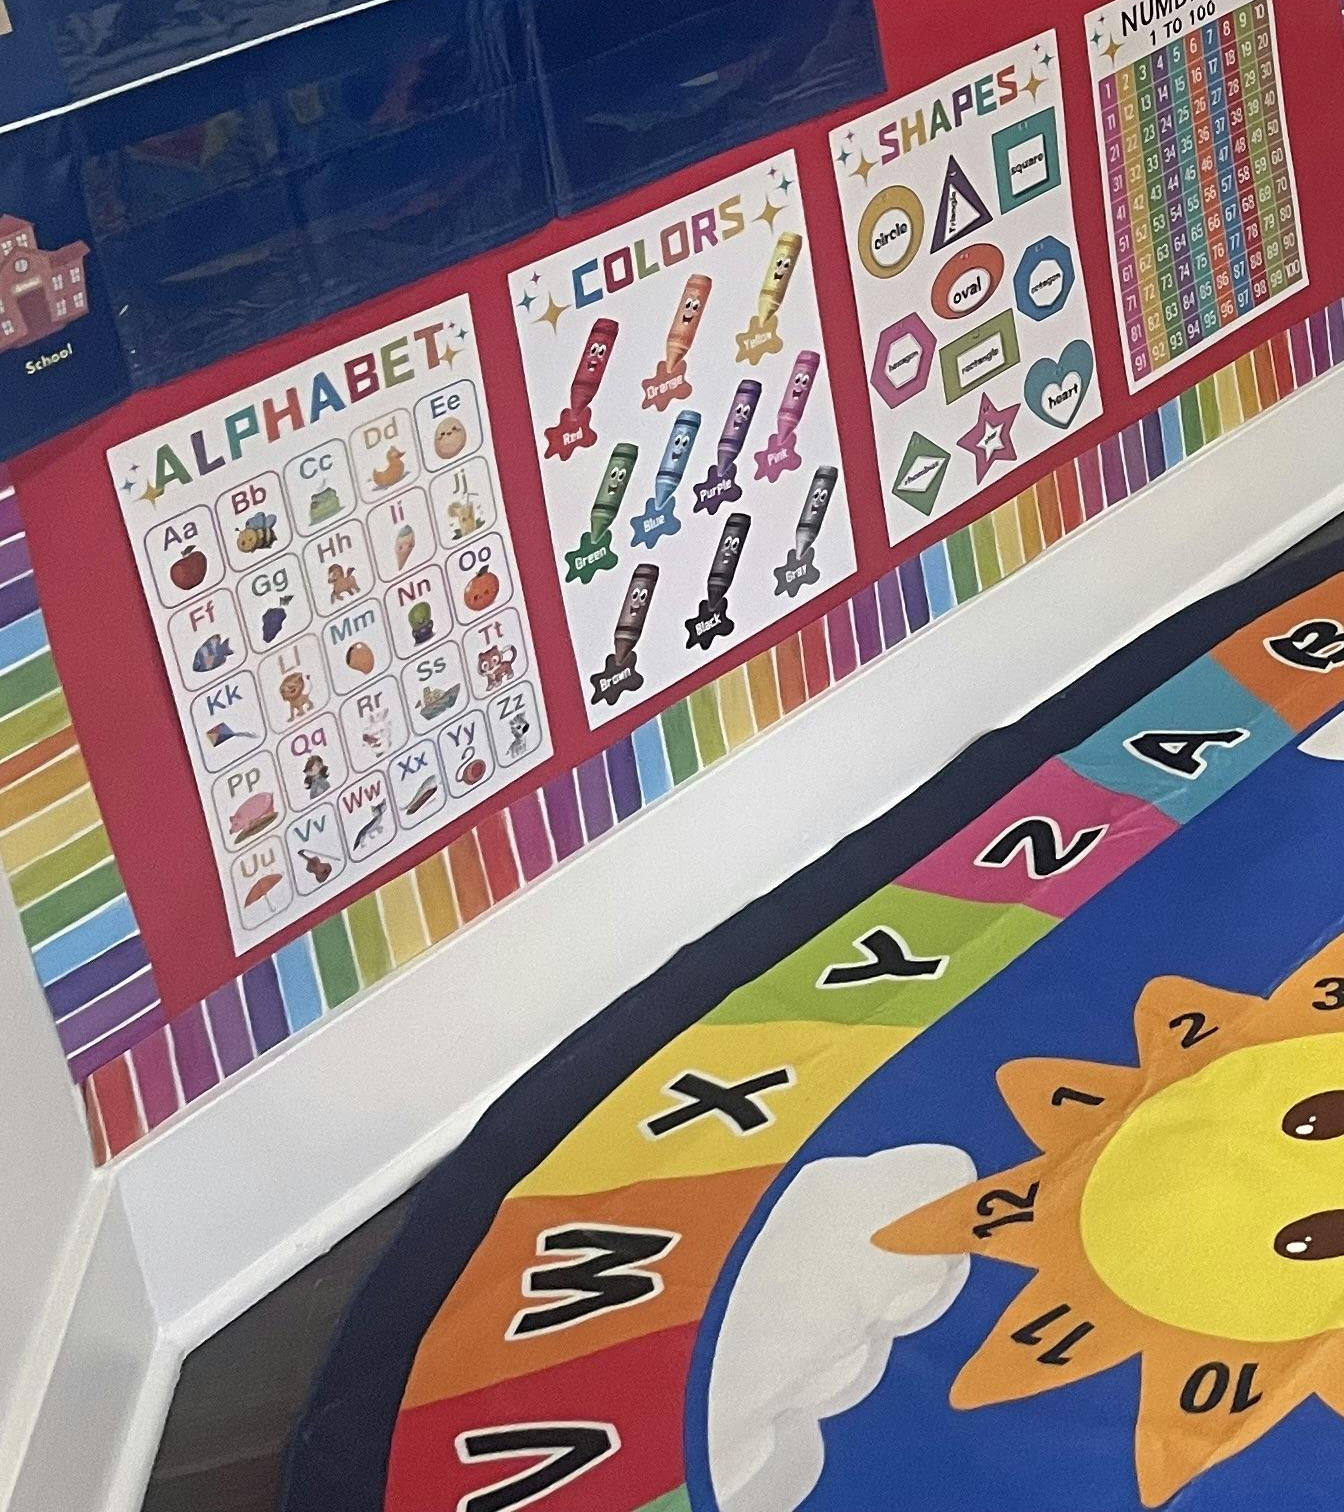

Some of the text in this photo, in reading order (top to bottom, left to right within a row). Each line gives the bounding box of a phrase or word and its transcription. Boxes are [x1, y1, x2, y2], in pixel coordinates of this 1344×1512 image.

[1149, 0, 1216, 47] 1 TO 100
[1105, 3, 1265, 99] 1 2 3 4 5 6 7 8 9 10
[878, 64, 1018, 166] SHAPES
[571, 194, 745, 309] COLORS
[874, 222, 908, 251] circle
[952, 276, 982, 305] oval
[25, 342, 73, 375] School
[646, 374, 684, 400] Orange
[1047, 383, 1079, 410] heart
[155, 322, 444, 496] ALPHABET
[431, 391, 461, 419] Ee
[362, 415, 398, 449] Dd
[562, 428, 584, 447] Red
[299, 452, 334, 480] Cc
[767, 448, 789, 466] Pink
[230, 485, 267, 515] Bb
[699, 477, 733, 502] Purple
[163, 519, 199, 551] Aa
[643, 513, 666, 533] Blue
[317, 531, 353, 563] Hh
[457, 544, 492, 572] Oo
[574, 546, 608, 571] Green
[250, 566, 289, 597] Gg
[785, 563, 808, 584] Gray
[398, 577, 432, 606] Nn
[188, 599, 216, 632] Ff
[328, 608, 377, 646] Mm
[695, 613, 722, 635] Black
[478, 619, 504, 645] Tt
[416, 656, 447, 682] Ss
[599, 666, 632, 692] Brown
[205, 683, 244, 716] Kk
[355, 689, 384, 718] Rr
[495, 692, 525, 721] Zz
[290, 727, 328, 757] Qq
[446, 720, 476, 748] Yy
[398, 751, 429, 782] Xx
[1125, 726, 1248, 779] A
[226, 766, 262, 798] Pp
[340, 779, 382, 814] Ww
[293, 813, 327, 843] Vv
[976, 815, 1108, 880] Z
[240, 848, 275, 879] Uu
[818, 925, 946, 989] Y
[1168, 1011, 1220, 1050] 2
[643, 1064, 793, 1140] X
[1050, 1085, 1106, 1107] 1
[971, 1180, 1041, 1240] 12
[509, 1225, 677, 1339] W
[1009, 1302, 1096, 1367] 11
[1178, 1361, 1264, 1415] 10
[460, 1423, 616, 1512] V
